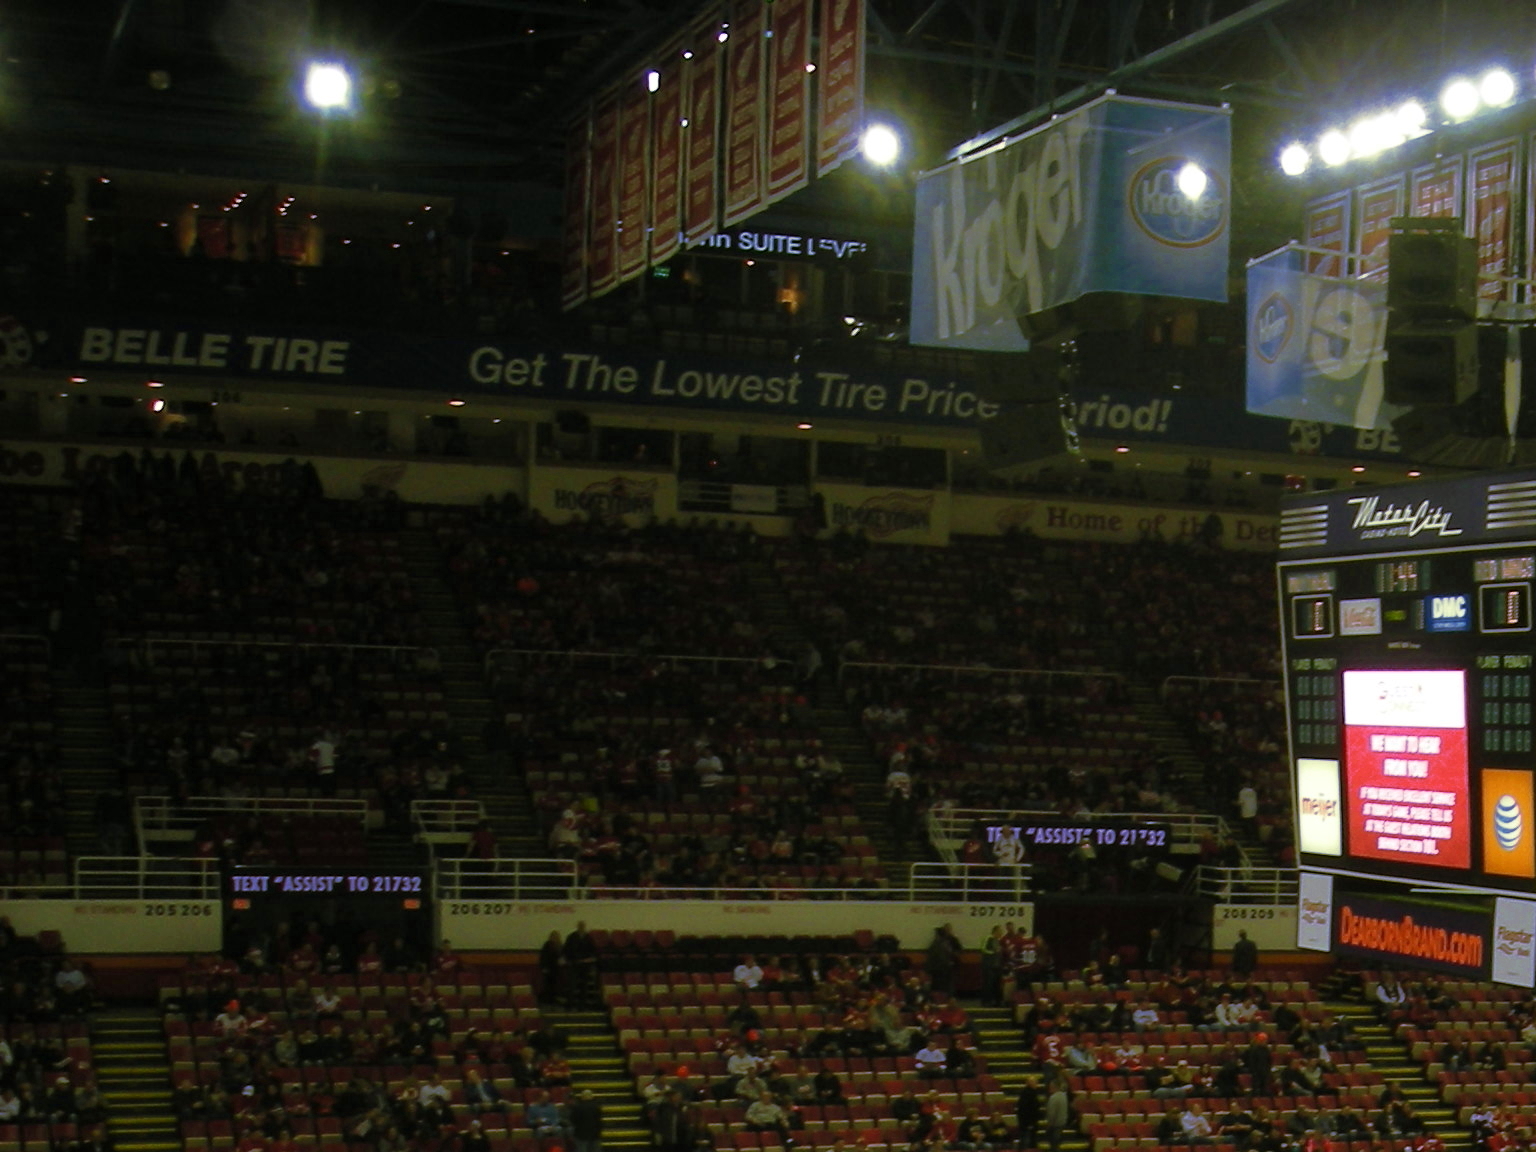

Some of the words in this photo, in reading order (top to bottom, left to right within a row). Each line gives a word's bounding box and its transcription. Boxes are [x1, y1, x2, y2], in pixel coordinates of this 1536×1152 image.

[932, 110, 1089, 340] Kroger
[738, 231, 799, 252] SUITE
[80, 327, 231, 368] BELLE
[246, 334, 351, 375] TIRE
[468, 346, 547, 388] Get
[561, 352, 640, 395] The
[651, 359, 803, 405] Lowest
[815, 371, 888, 412] Tire
[900, 378, 1000, 420] Price
[1047, 505, 1121, 534] Home
[1136, 513, 1168, 536] of
[1431, 596, 1467, 619] DMC
[986, 826, 1021, 844] TET
[1097, 828, 1116, 846] TO
[232, 876, 270, 892] TEXT
[346, 876, 370, 892] TO
[373, 876, 422, 892] 21732
[144, 904, 178, 917] 205
[180, 904, 213, 917] 206
[450, 903, 481, 916] 206
[482, 903, 513, 916] 207
[969, 905, 996, 918] 207
